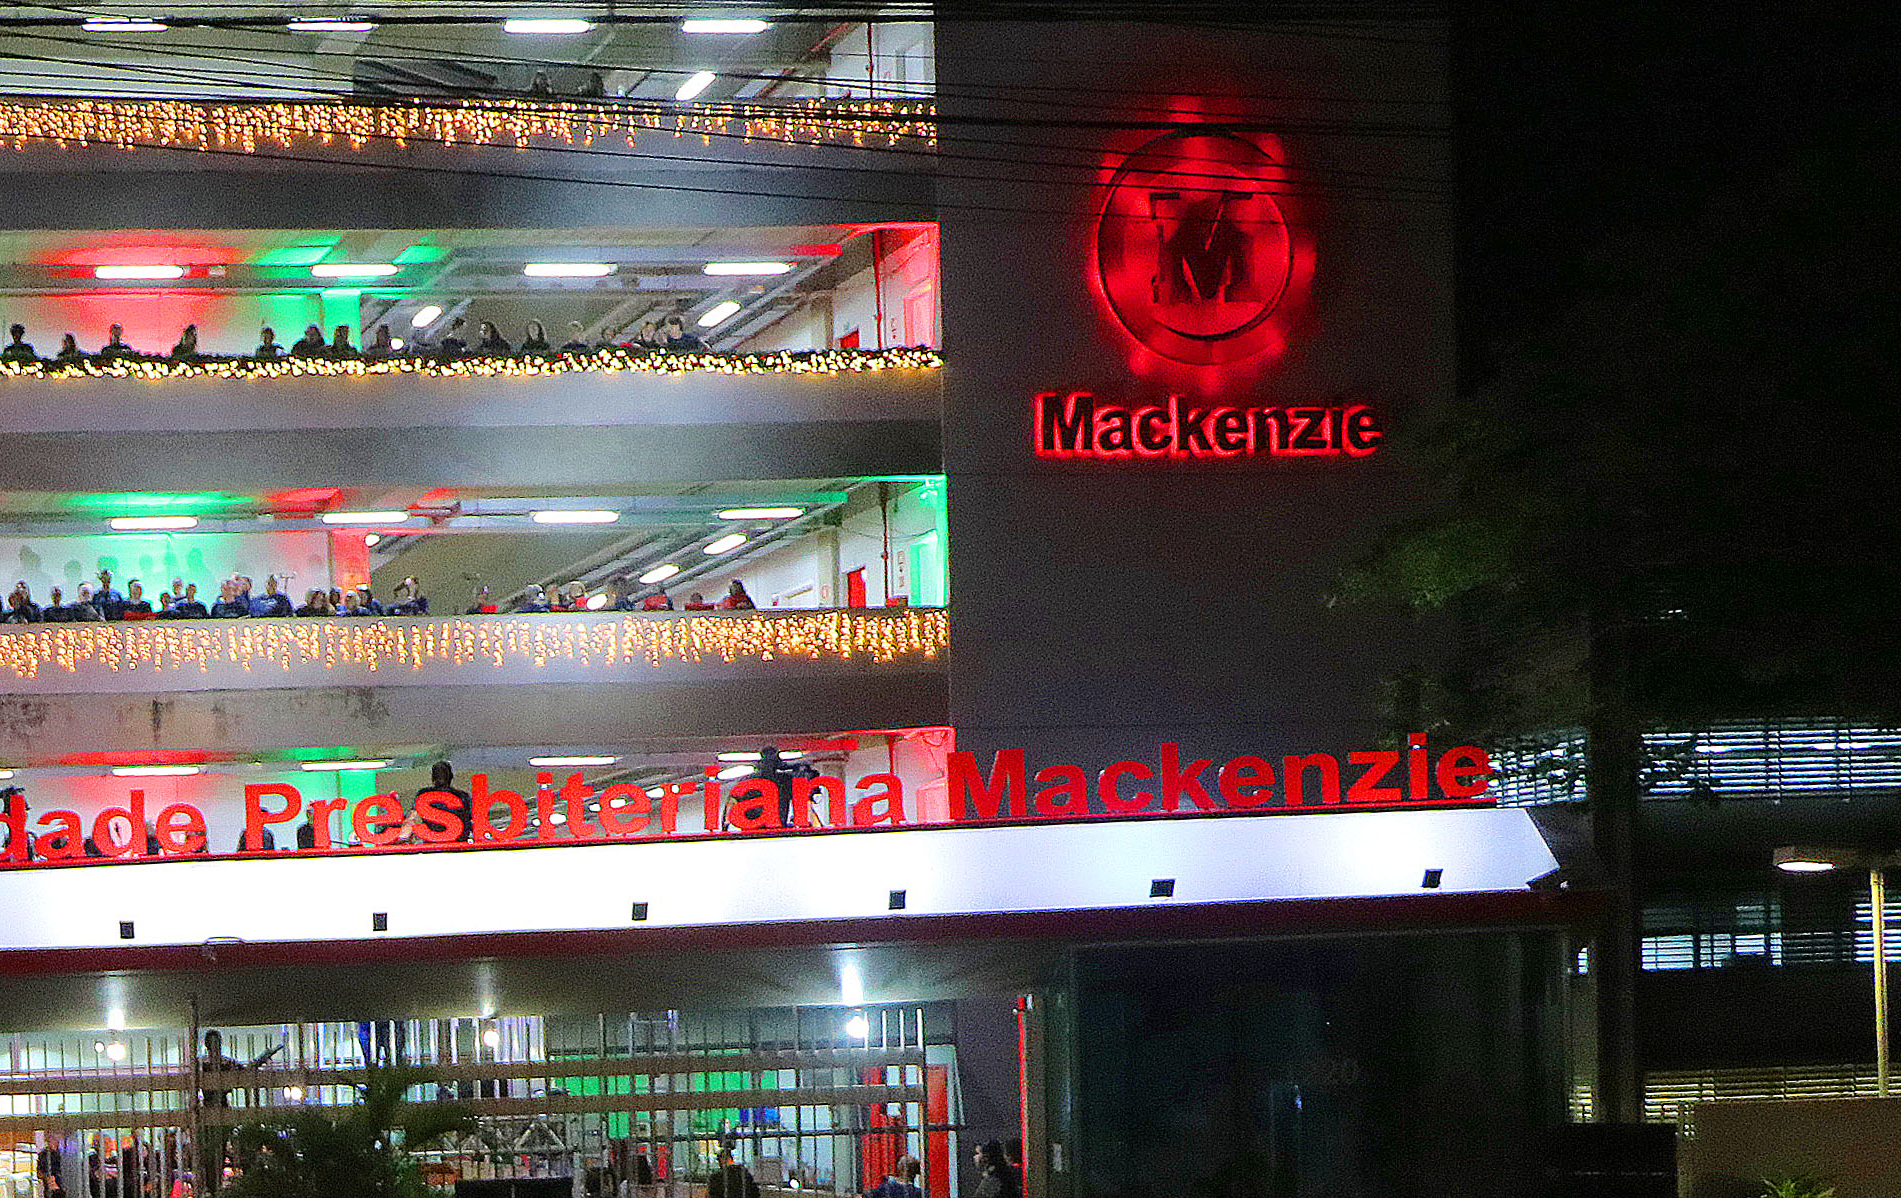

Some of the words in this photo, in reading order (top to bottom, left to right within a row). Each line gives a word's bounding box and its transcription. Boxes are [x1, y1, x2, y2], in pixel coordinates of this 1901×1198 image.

[1034, 391, 1383, 457] Mackenzie
[243, 764, 905, 850] Presbiteriana
[947, 732, 1491, 819] Mackenzie
